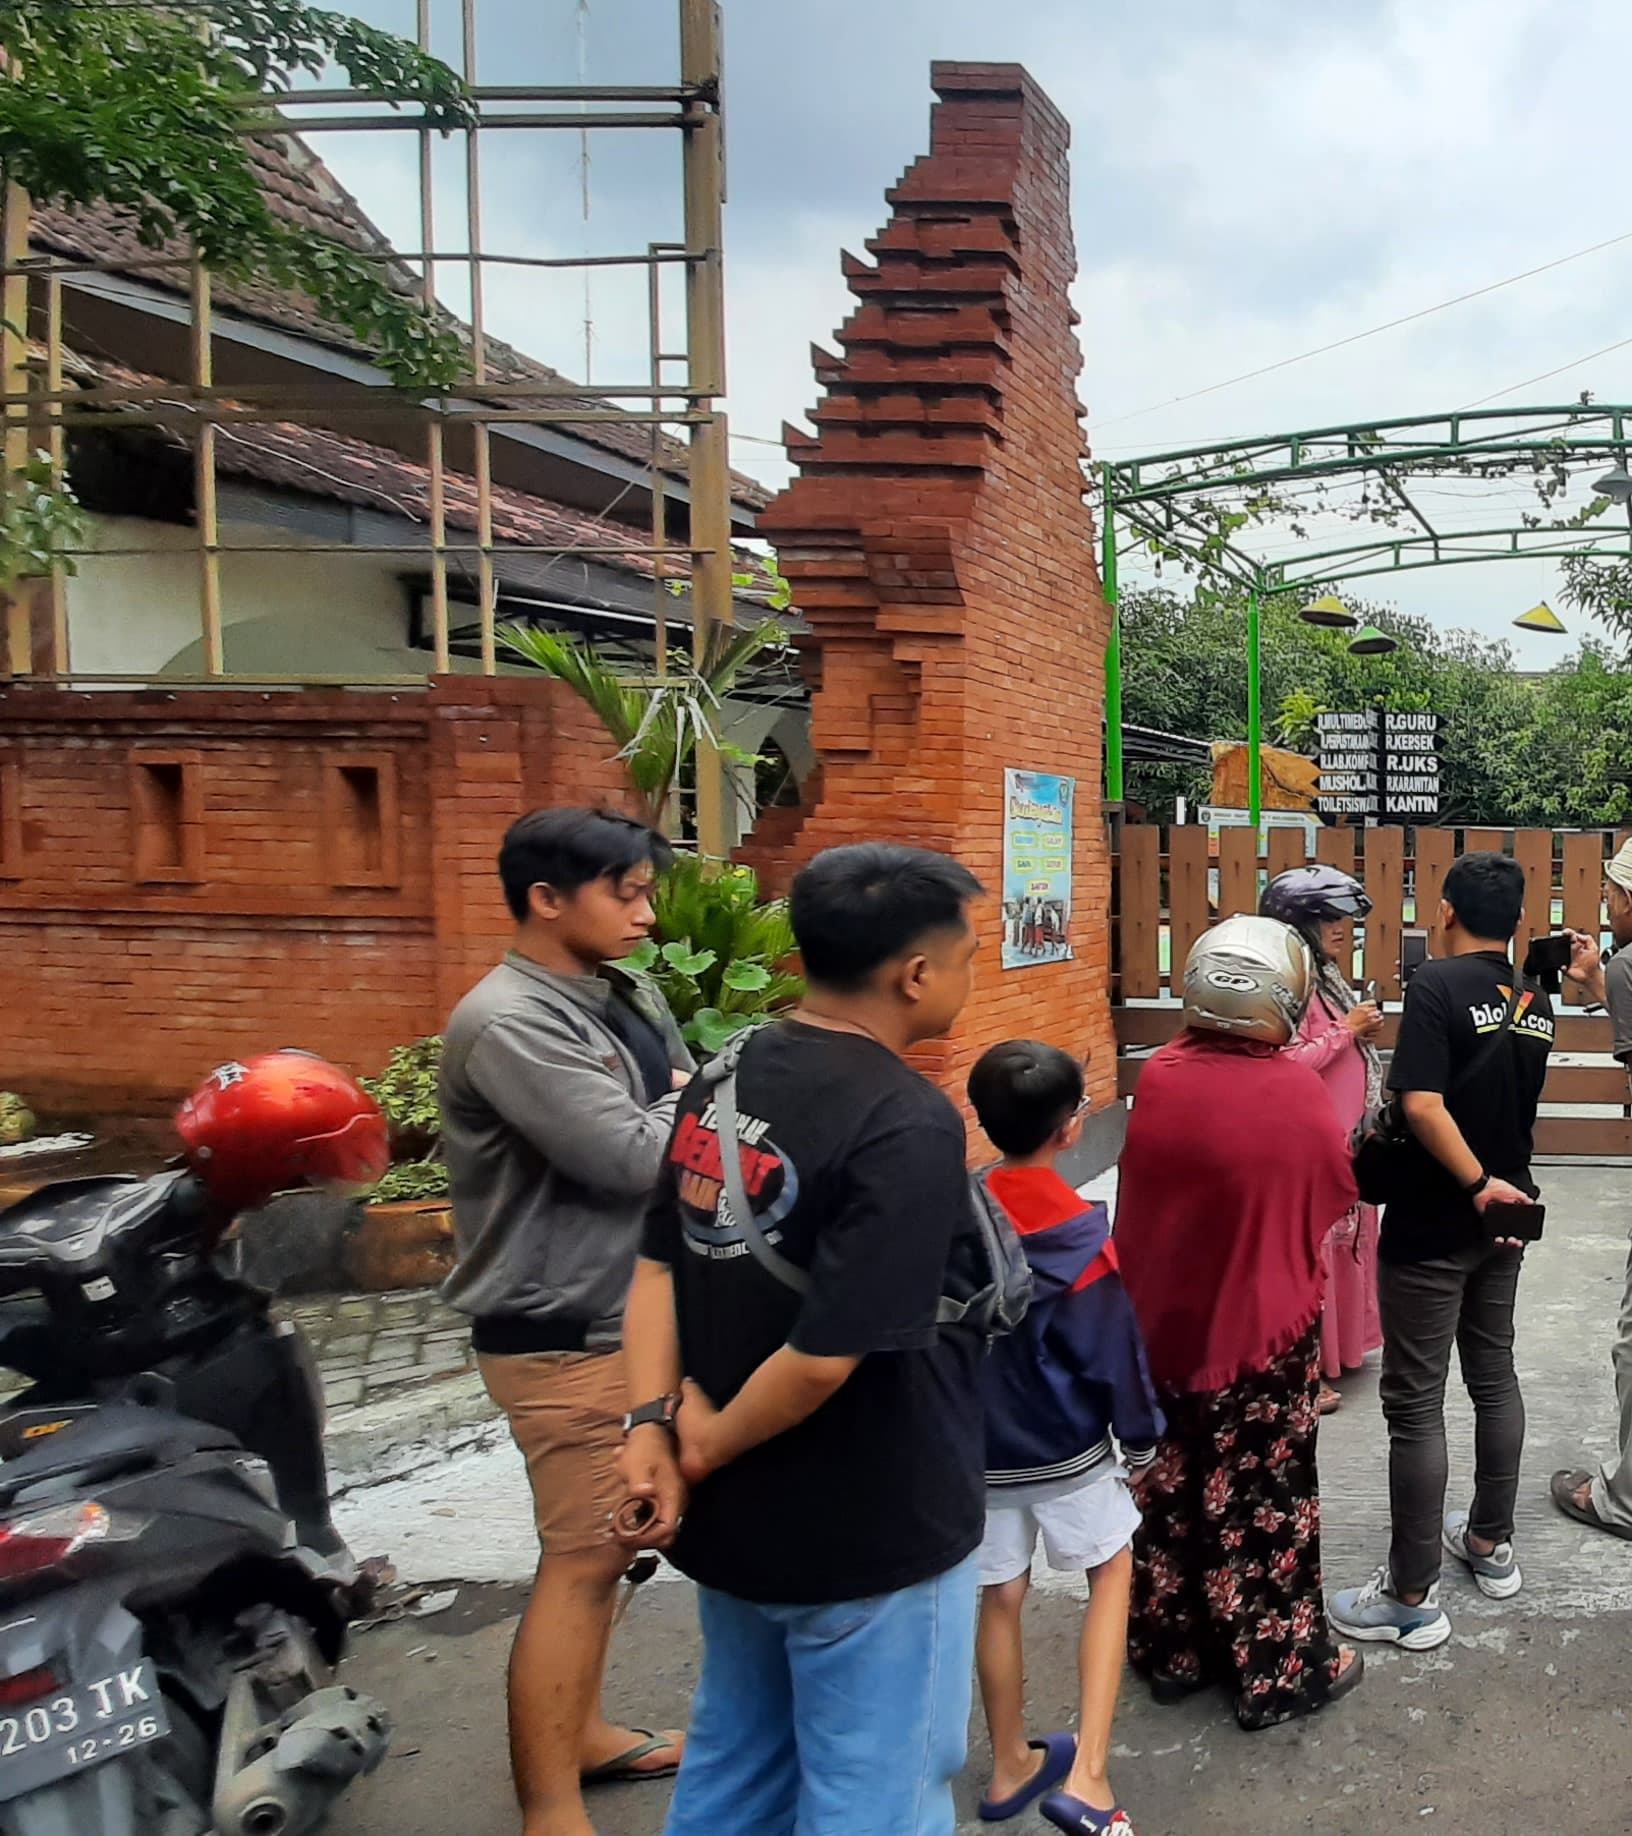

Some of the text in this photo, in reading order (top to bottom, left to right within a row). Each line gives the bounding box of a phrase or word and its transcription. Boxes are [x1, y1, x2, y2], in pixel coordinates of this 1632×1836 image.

[1385, 714, 1437, 730] R.GURU
[1386, 755, 1438, 772] R.UKS
[1386, 796, 1438, 813] KANTIN
[1214, 974, 1249, 985] GP
